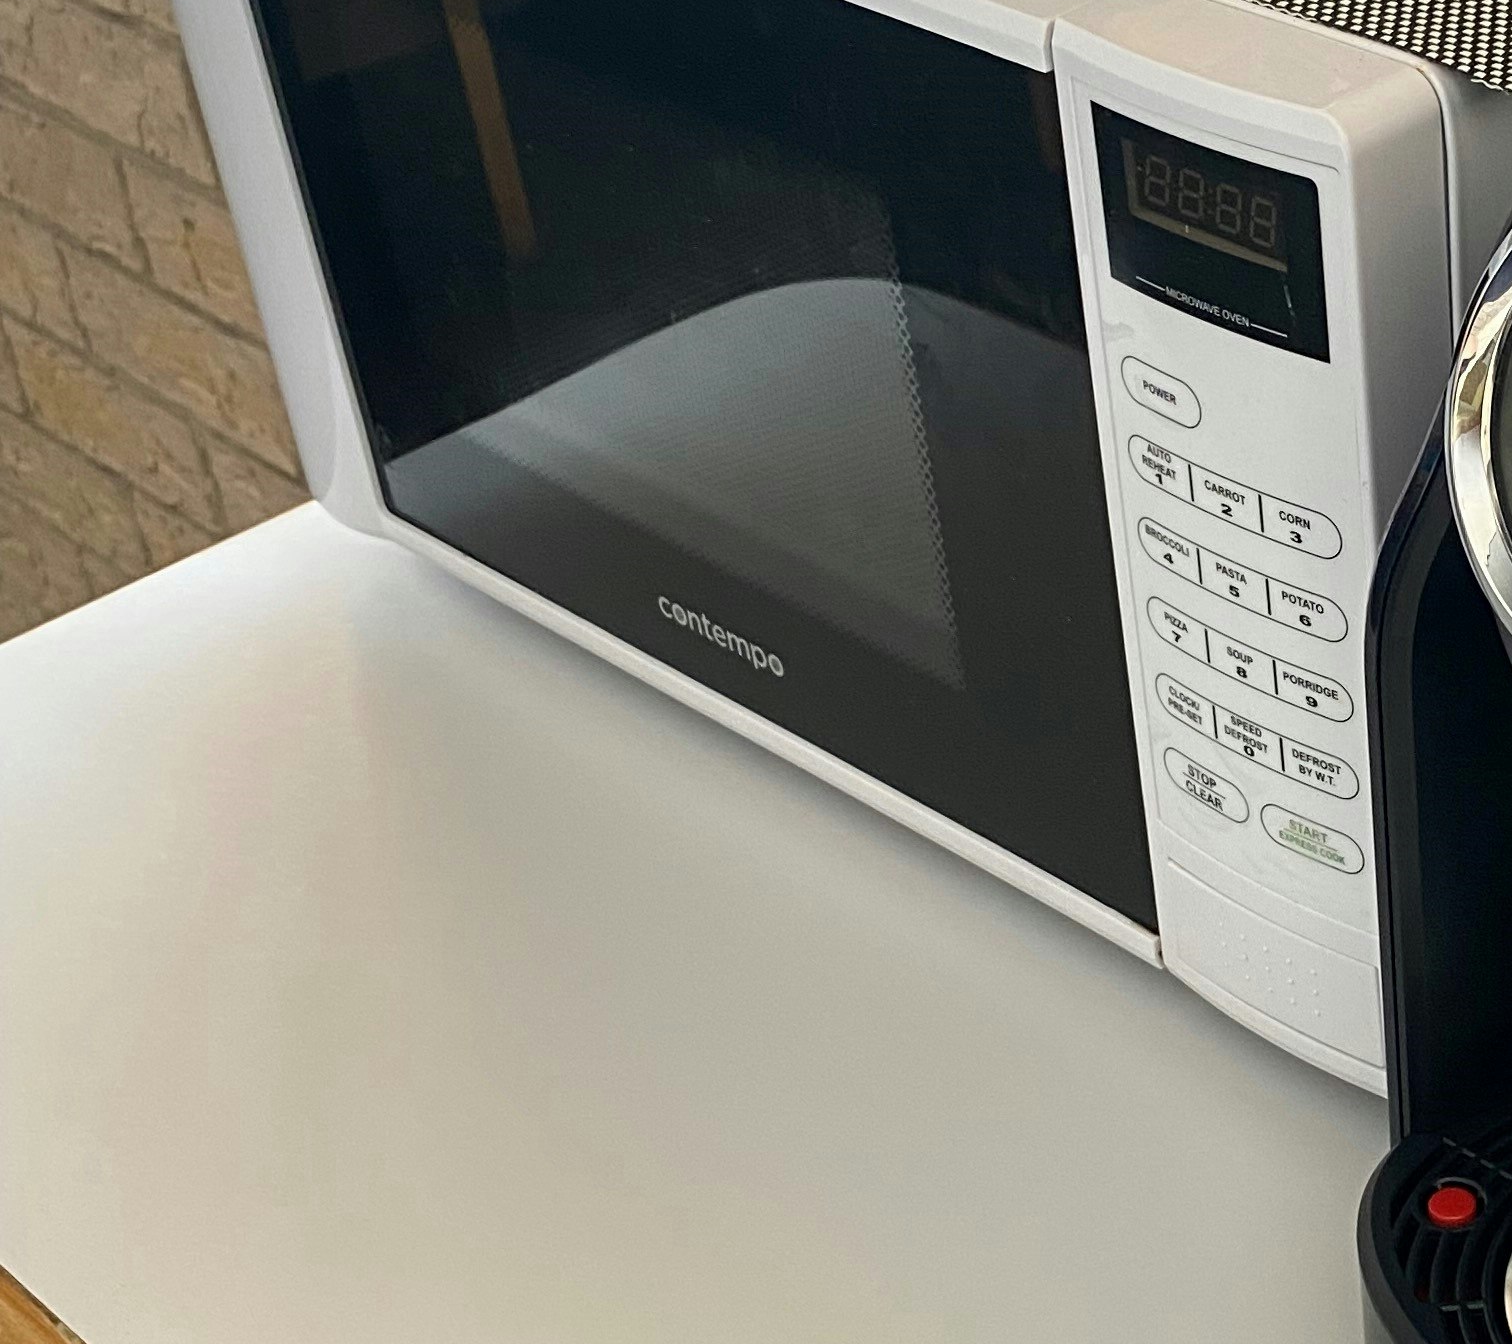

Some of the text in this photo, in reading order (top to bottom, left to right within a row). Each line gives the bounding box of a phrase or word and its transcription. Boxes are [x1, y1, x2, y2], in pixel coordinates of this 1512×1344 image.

[1165, 285, 1251, 328] MICROWAVE OVEN
[1142, 380, 1177, 405] POWER
[1147, 444, 1172, 464] AUTO
[1142, 454, 1177, 480] REHEAT
[1155, 473, 1164, 485] 1
[1204, 479, 1246, 506] CARROT
[1220, 503, 1233, 517] 2
[1279, 510, 1311, 530] CORN
[1145, 524, 1190, 557] BROCCOLI
[1289, 531, 1303, 544] 3
[1163, 552, 1174, 564] 4
[1215, 562, 1247, 584] PASTA
[1229, 585, 1240, 598] 5
[1281, 590, 1325, 614] POTATO
[1164, 611, 1188, 633] PIZZA
[1299, 614, 1312, 627] 6
[658, 596, 785, 677] contempo
[1172, 630, 1182, 643] 7
[1226, 646, 1253, 664] SOUP
[1236, 666, 1248, 679] 8
[1282, 671, 1339, 701] PORRIDGE
[1305, 695, 1318, 707] 9
[1230, 715, 1262, 737] SPEED
[1224, 724, 1268, 753] DEFROST
[1243, 744, 1255, 757] 0
[1291, 748, 1342, 775] DEFROST
[1186, 764, 1217, 788] STOP
[1298, 764, 1312, 778] BY
[1185, 780, 1223, 811] CLEAR
[1288, 818, 1328, 844] START
